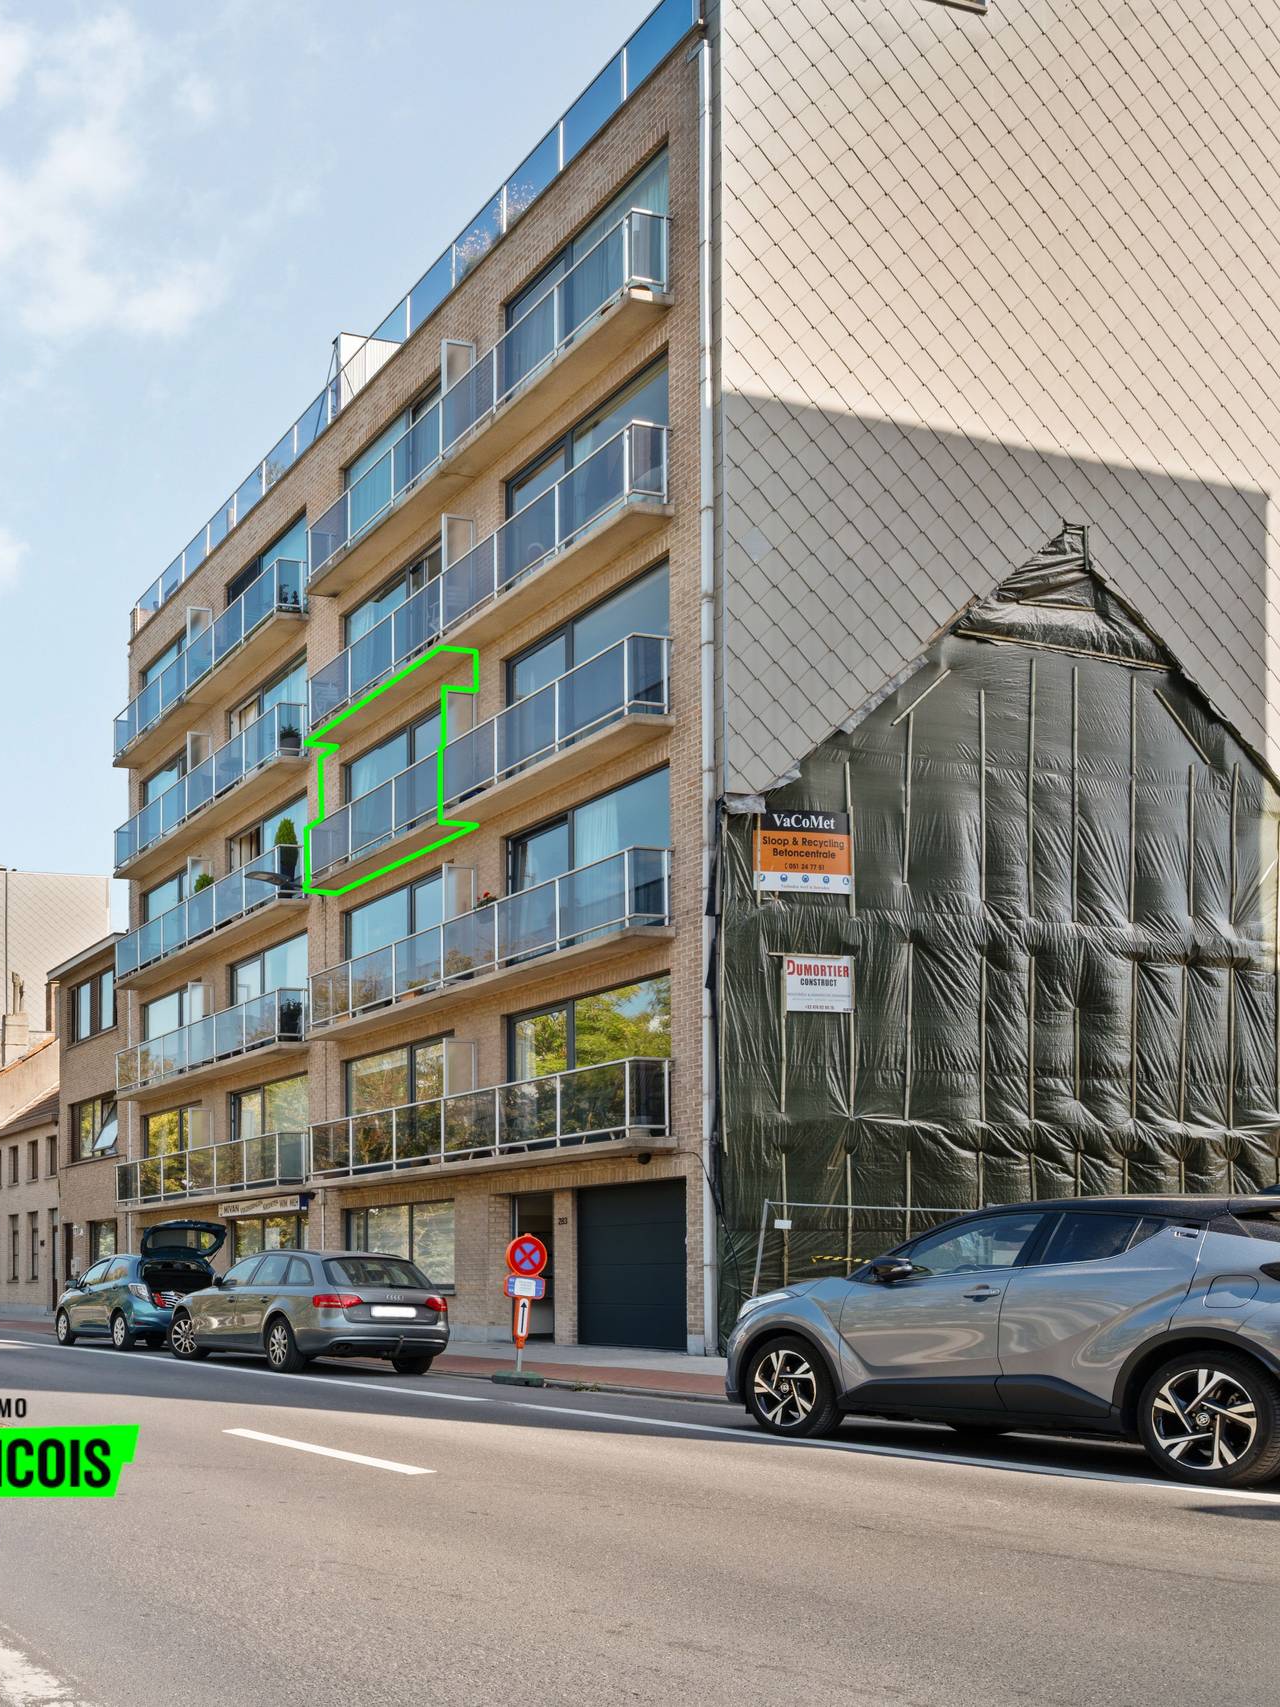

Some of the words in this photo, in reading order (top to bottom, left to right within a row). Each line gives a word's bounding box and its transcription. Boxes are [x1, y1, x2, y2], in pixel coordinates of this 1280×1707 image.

[772, 813, 836, 830] VaCoMet
[762, 836, 789, 847] Sloop
[792, 837, 799, 846] &
[801, 837, 845, 849] Recycling
[772, 847, 836, 860] Betoncentrale
[786, 959, 849, 978] DUMORTIER
[800, 977, 837, 987] CONSTRUCT
